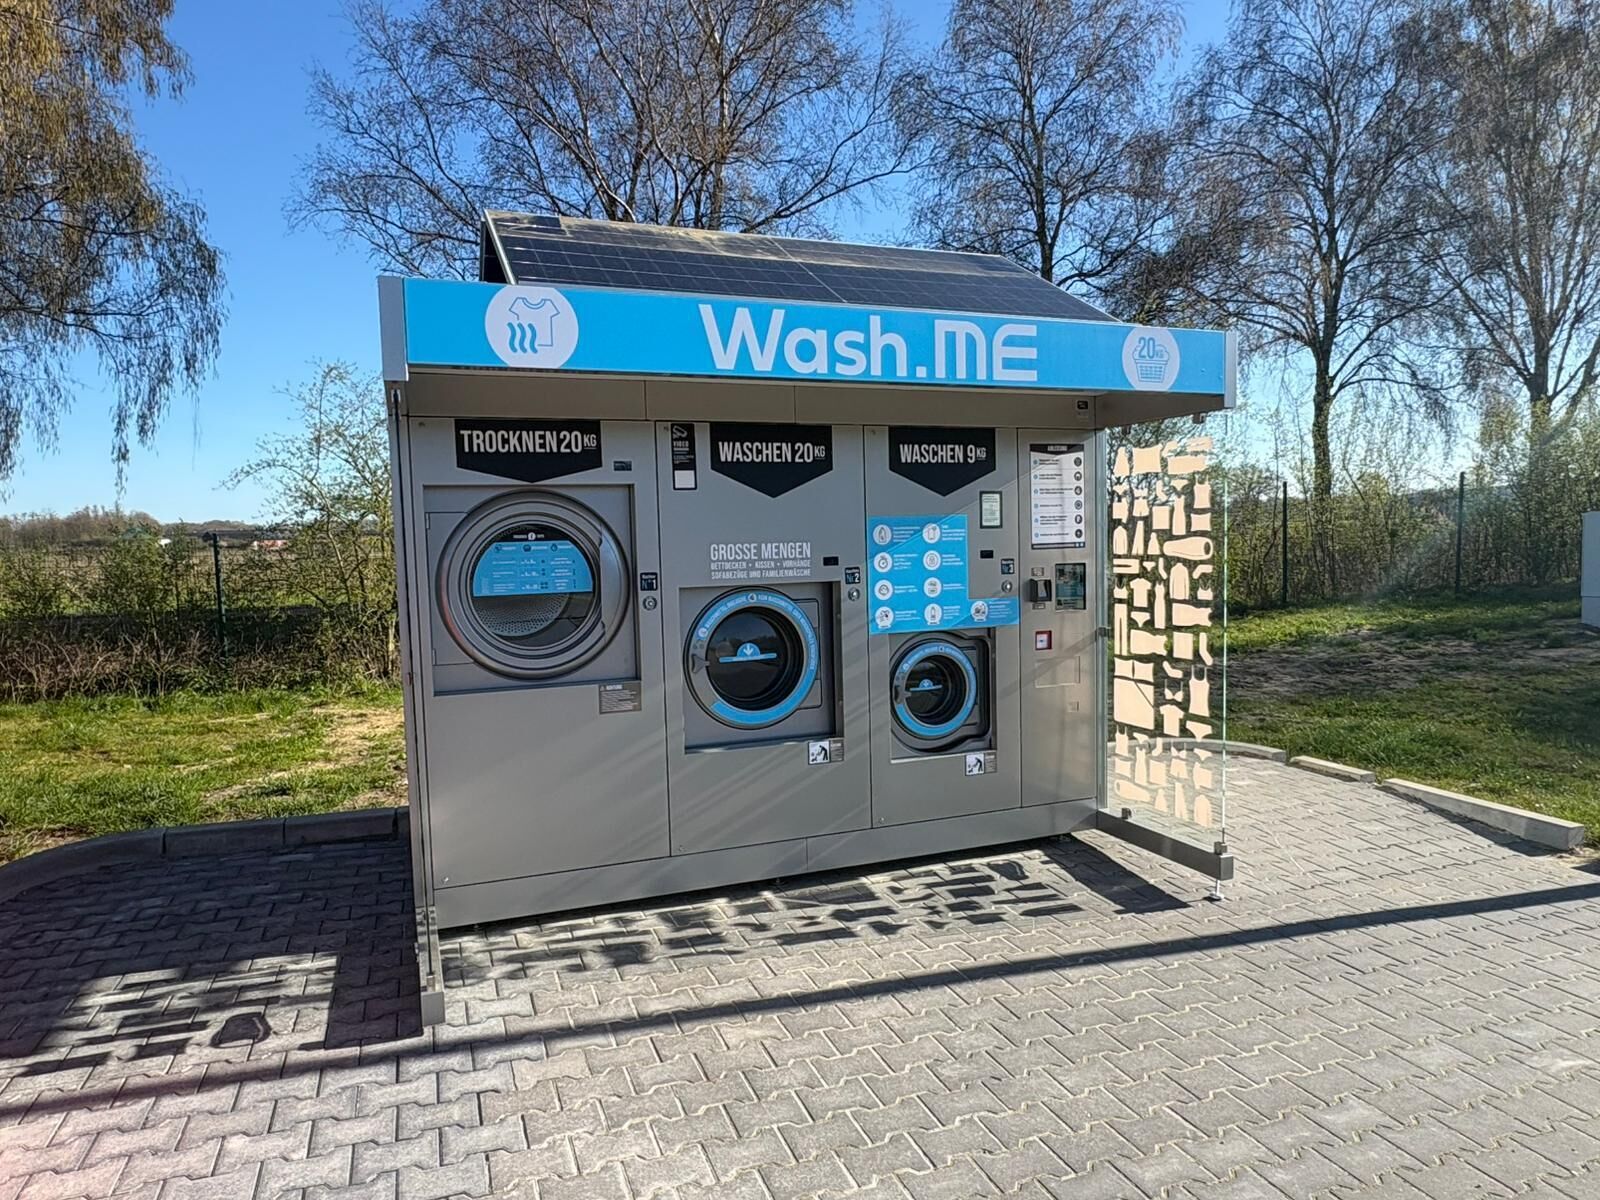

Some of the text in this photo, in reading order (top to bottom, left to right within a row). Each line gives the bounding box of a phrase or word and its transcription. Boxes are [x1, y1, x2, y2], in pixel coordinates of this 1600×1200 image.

[697, 303, 1038, 382] Wash.ME
[460, 429, 557, 454] TROCKNEN
[718, 440, 791, 463] WASCHEN
[899, 443, 963, 464] WASCHEN
[710, 542, 811, 561] GROSSE MENGEN
[754, 561, 775, 570] KISSEN
[855, 573, 860, 582] 2
